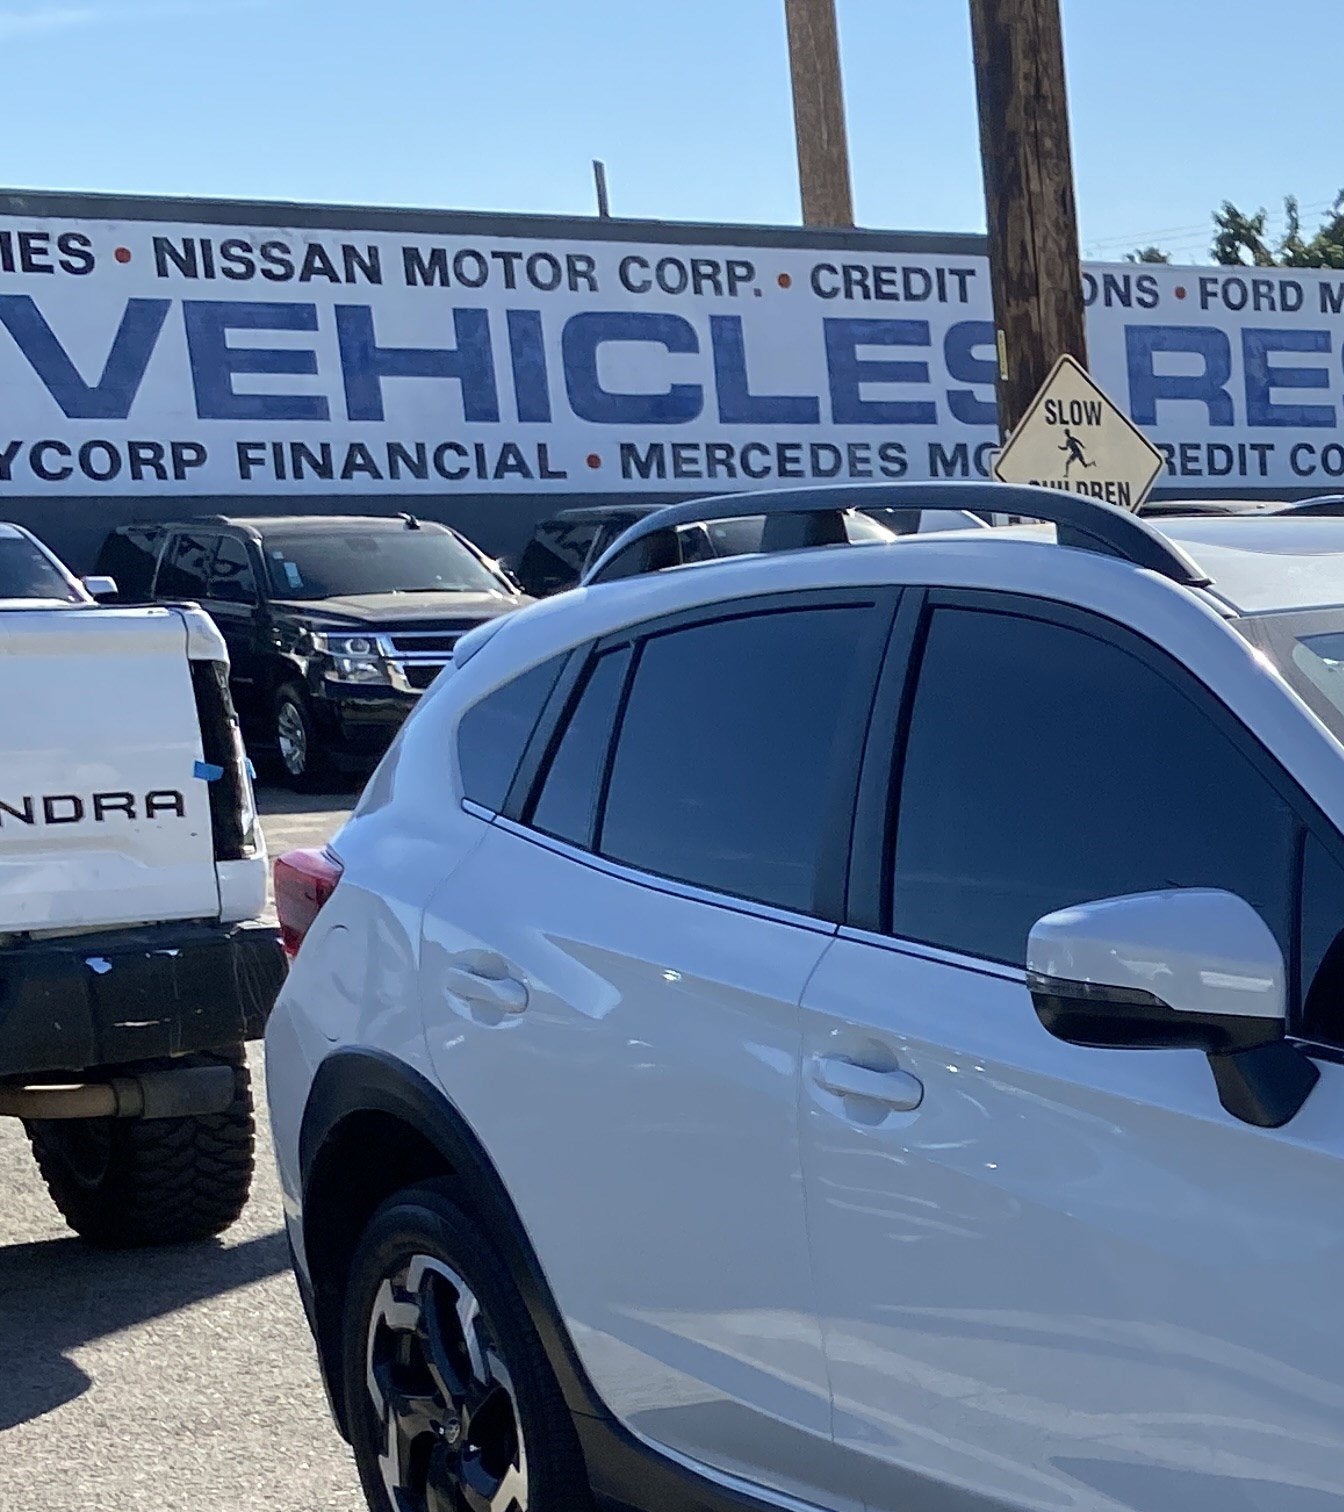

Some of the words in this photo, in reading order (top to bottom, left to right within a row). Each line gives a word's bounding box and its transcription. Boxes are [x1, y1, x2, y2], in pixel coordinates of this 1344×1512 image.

[153, 236, 382, 284] NISSAN
[404, 246, 598, 292] MOTOR
[619, 256, 763, 297] CORP.
[811, 263, 976, 303] CREDIT
[1199, 276, 1303, 312] FORD
[1045, 399, 1102, 426] SLOW
[237, 442, 568, 481] FINANCIAL
[620, 443, 908, 480] MERCEDES
